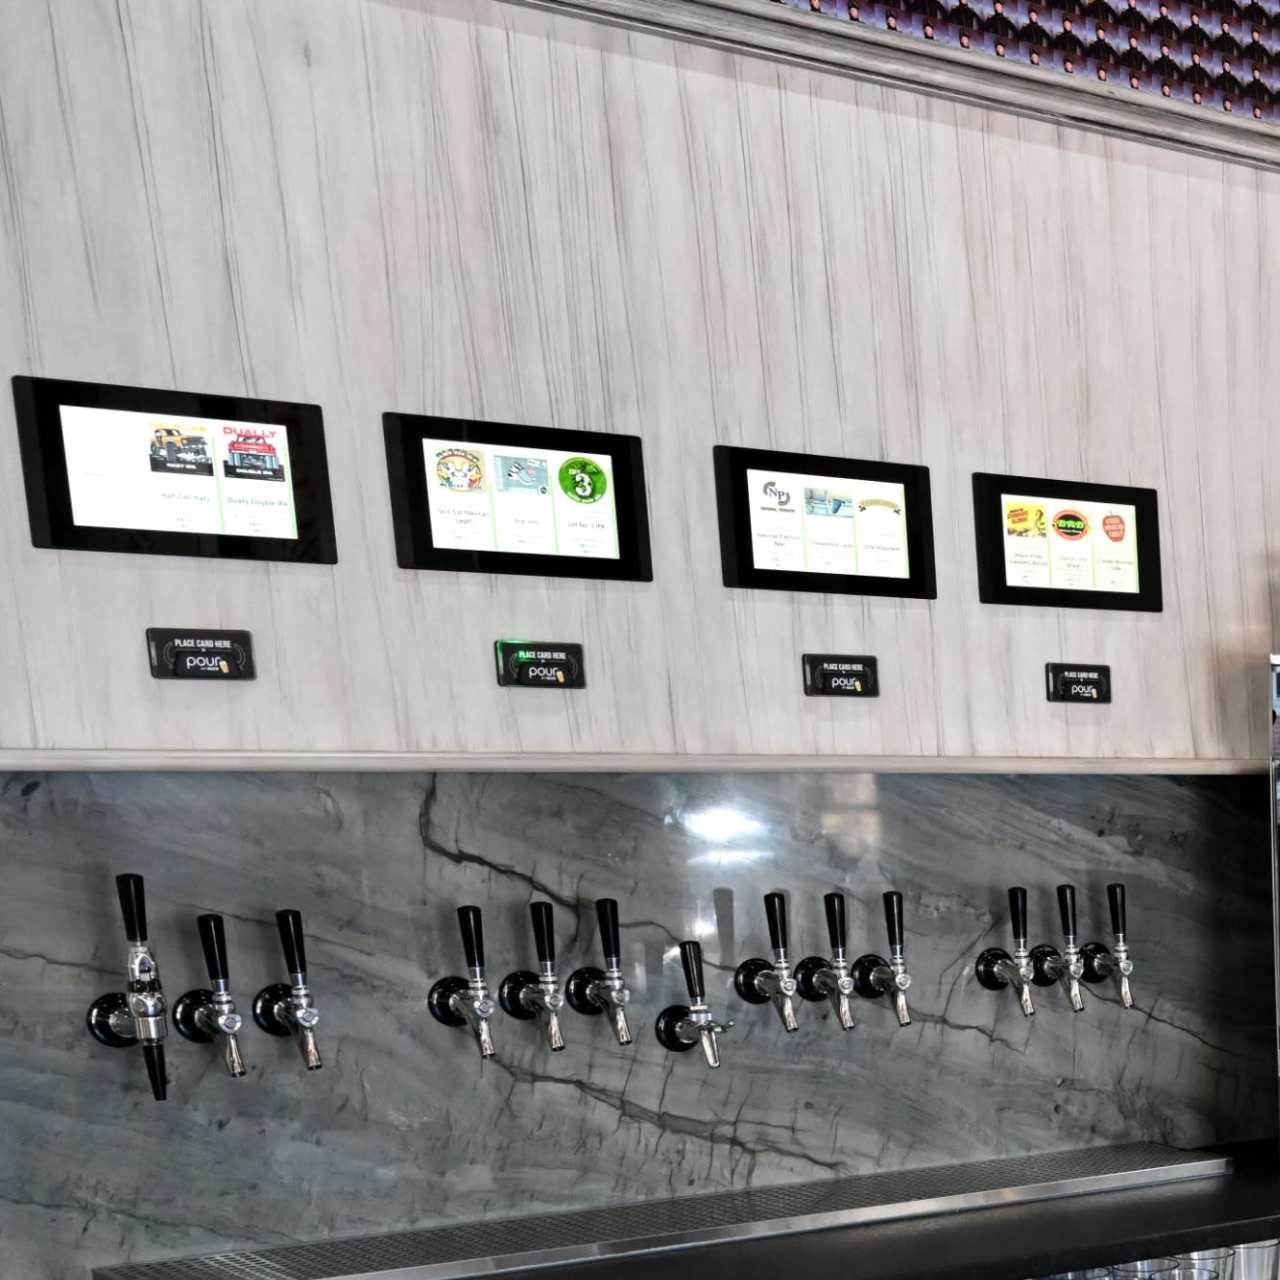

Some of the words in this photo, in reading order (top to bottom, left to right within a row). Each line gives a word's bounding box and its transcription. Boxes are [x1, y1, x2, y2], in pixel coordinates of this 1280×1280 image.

[174, 638, 195, 648] PLACE
[196, 639, 214, 648] CARD
[215, 640, 232, 648] HERE
[518, 650, 536, 659] PLACE
[537, 651, 552, 659] CARD
[552, 652, 567, 660] HERE
[186, 656, 221, 670] pour
[529, 667, 558, 680] pour
